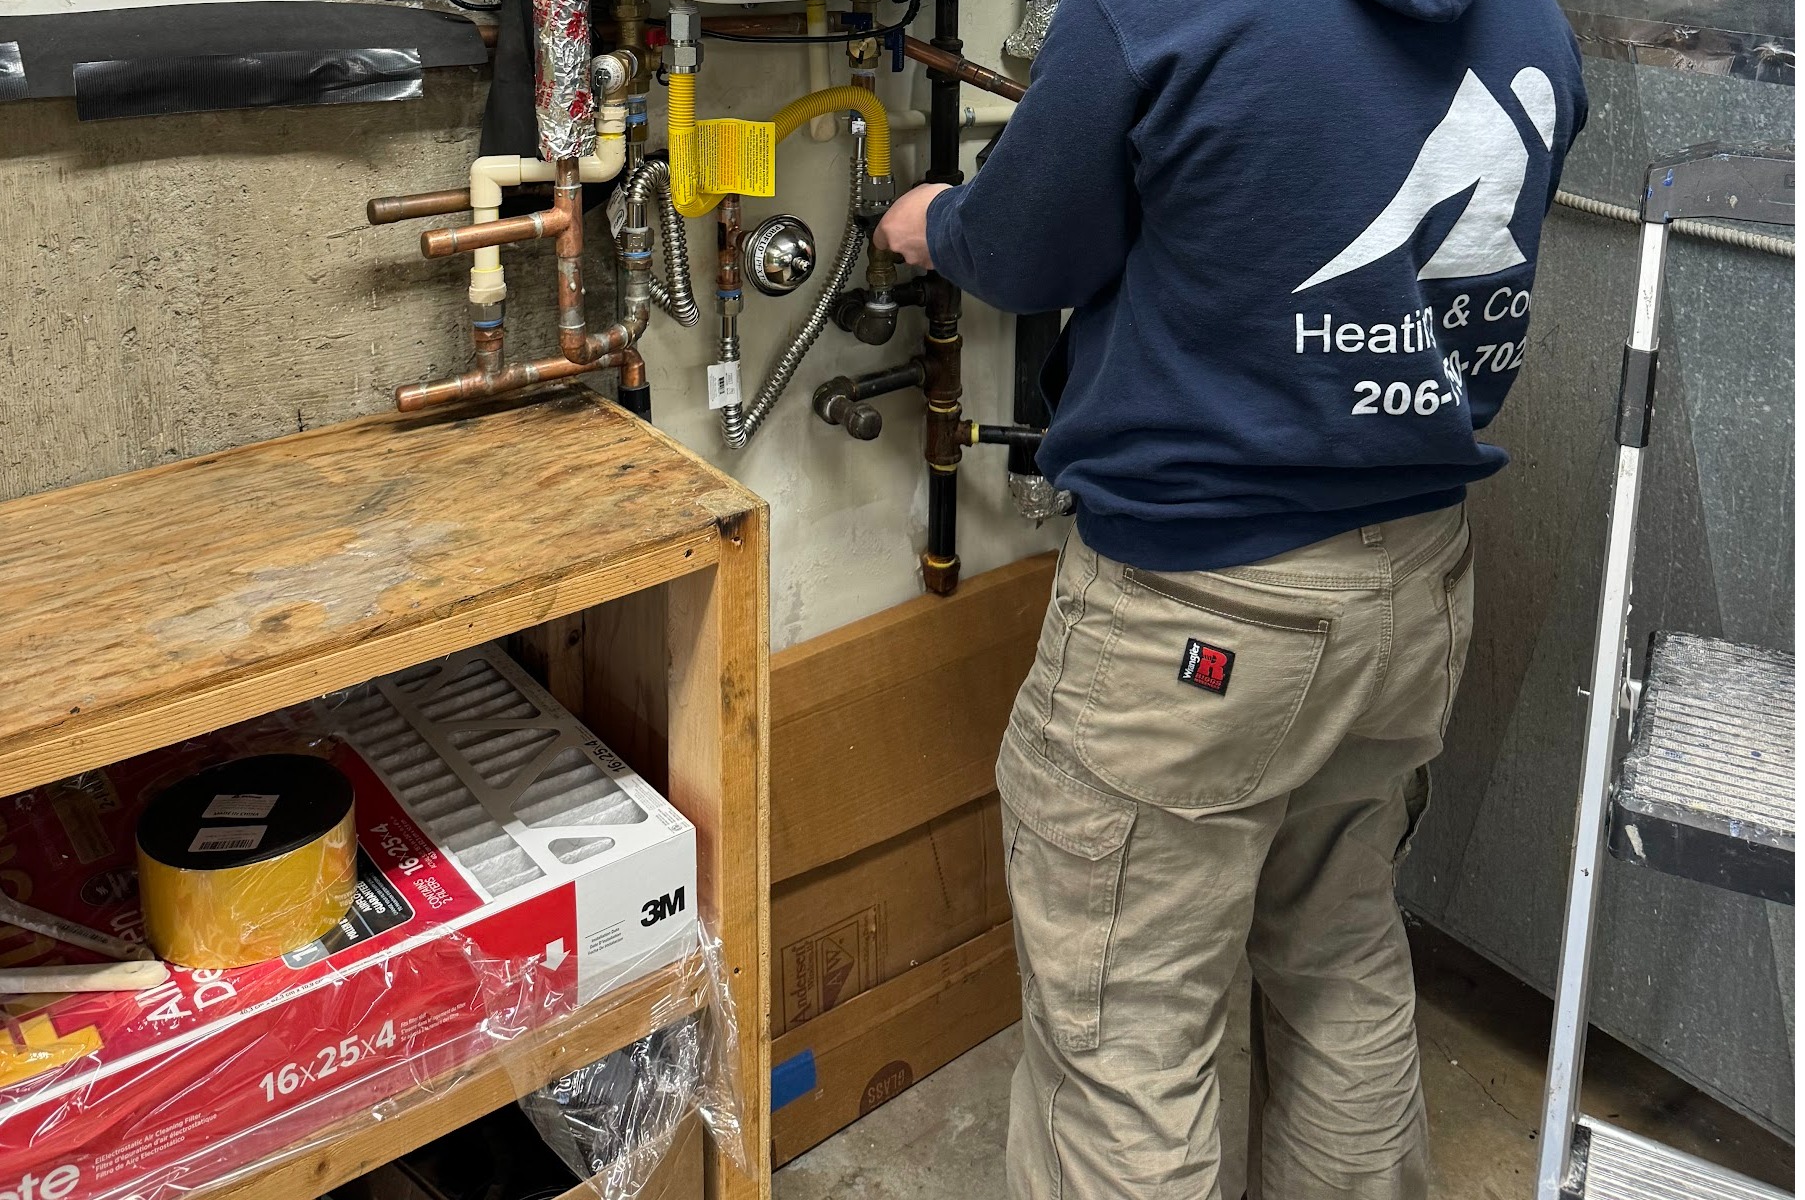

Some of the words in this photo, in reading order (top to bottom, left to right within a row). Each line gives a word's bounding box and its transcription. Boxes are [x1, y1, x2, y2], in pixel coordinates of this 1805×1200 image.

[758, 225, 780, 251] PROFLO
[1294, 306, 1437, 354] Heatin
[1442, 294, 1470, 330] &
[1484, 286, 1531, 322] Co
[1182, 643, 1200, 679] Wrangler
[584, 737, 625, 773] 16x25x4
[370, 822, 424, 877] 16x25x4
[361, 879, 387, 912] GUARANTEED
[413, 877, 443, 908] CONTAINS
[426, 875, 450, 897] FILTERS
[640, 886, 687, 930] 3M
[789, 944, 811, 1023] Andersen
[259, 1018, 398, 1104] 16x25x4
[867, 1068, 908, 1105] GLASS
[143, 1132, 154, 1142] Air
[154, 1120, 184, 1137] Cleaning
[183, 1111, 202, 1124] Filter
[94, 1167, 114, 1179] Filtro
[95, 1159, 113, 1172] Filtre
